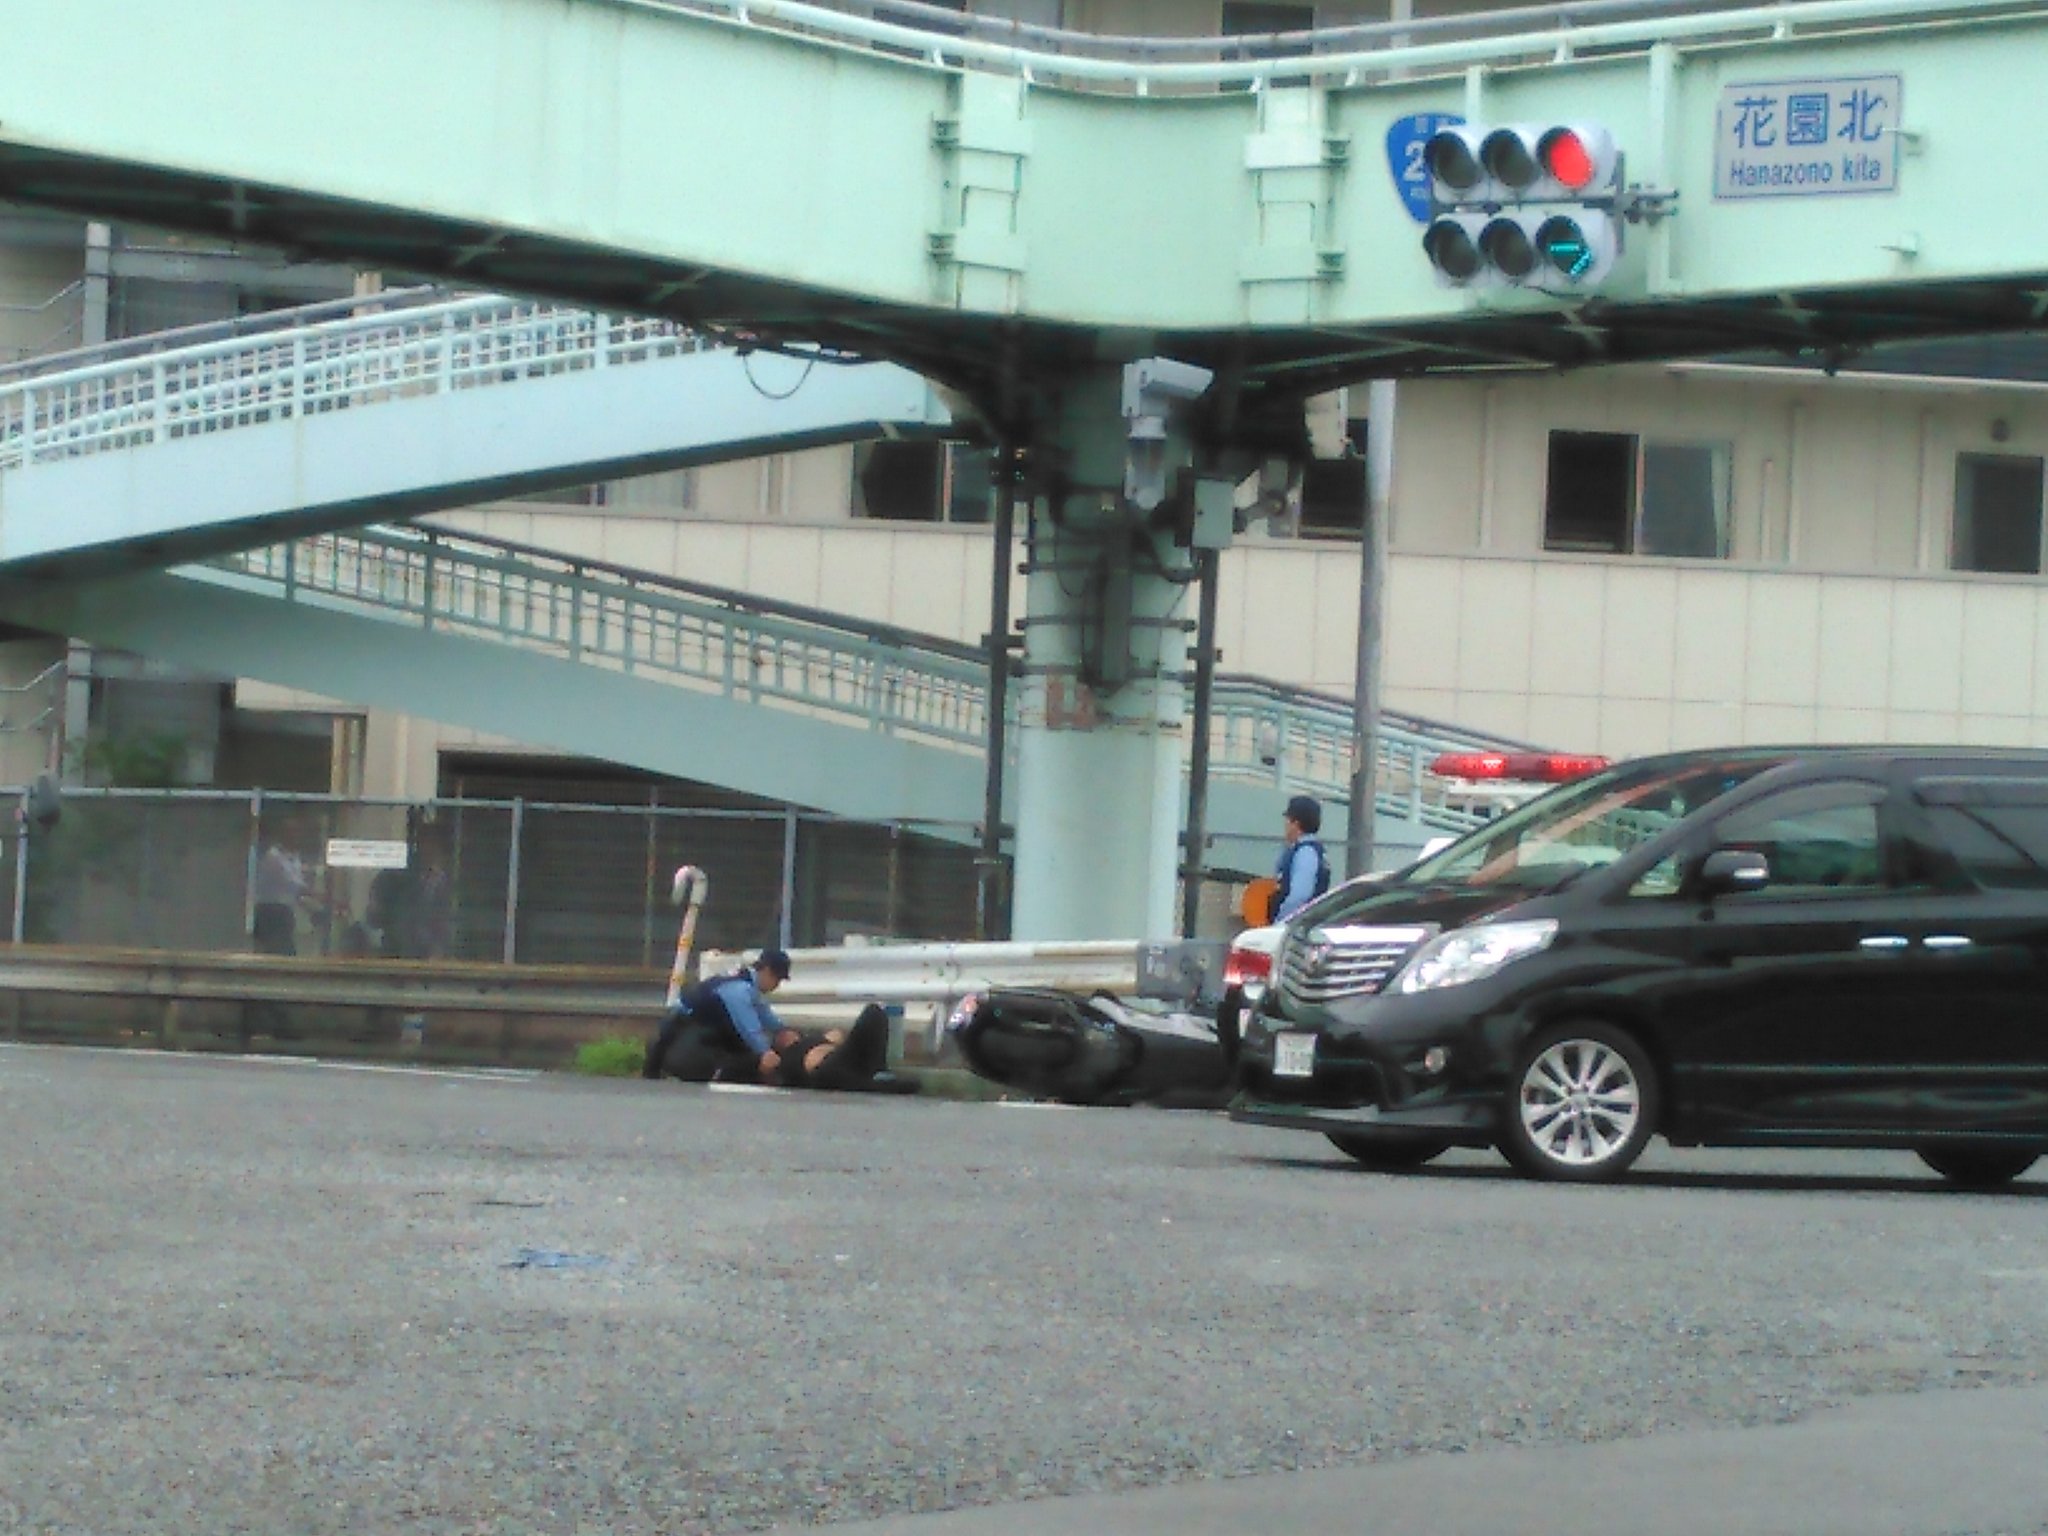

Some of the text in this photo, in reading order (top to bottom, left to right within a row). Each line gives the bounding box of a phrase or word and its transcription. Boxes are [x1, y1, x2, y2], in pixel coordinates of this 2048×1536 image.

[1734, 88, 1888, 148] 花園北
[1404, 140, 1426, 181] 2
[1731, 153, 1881, 186] Hanazono kita
